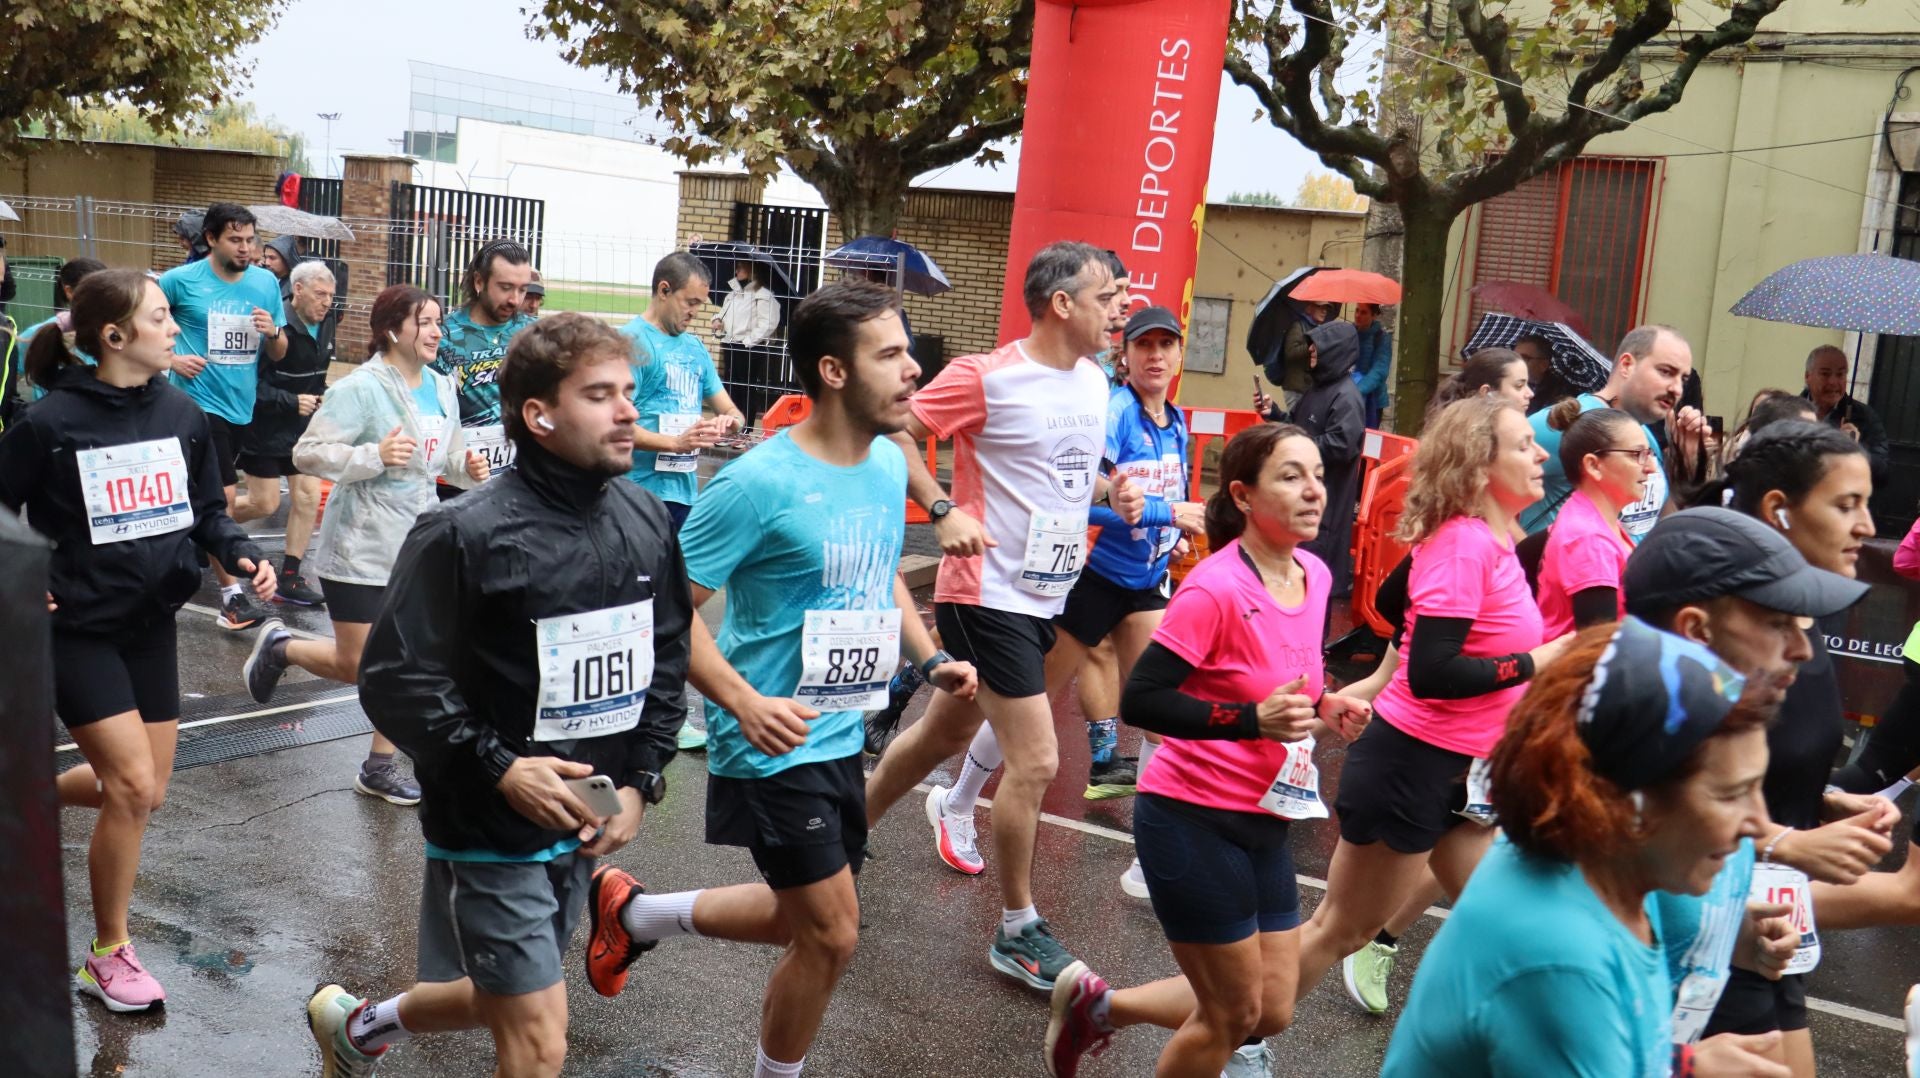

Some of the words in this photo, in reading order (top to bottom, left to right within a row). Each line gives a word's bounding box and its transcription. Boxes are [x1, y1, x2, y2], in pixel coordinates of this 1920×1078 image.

[1131, 37, 1191, 253] DEPORTES
[225, 331, 248, 350] 891
[1046, 416, 1058, 430] LA
[1060, 415, 1077, 429] CASA
[106, 472, 173, 513] 1040
[134, 516, 179, 531] HYUNDAI
[1050, 543, 1079, 573] 716
[1281, 644, 1317, 670] Todo
[1847, 639, 1870, 653] DE
[572, 648, 634, 703] 1061
[824, 647, 880, 685] 838
